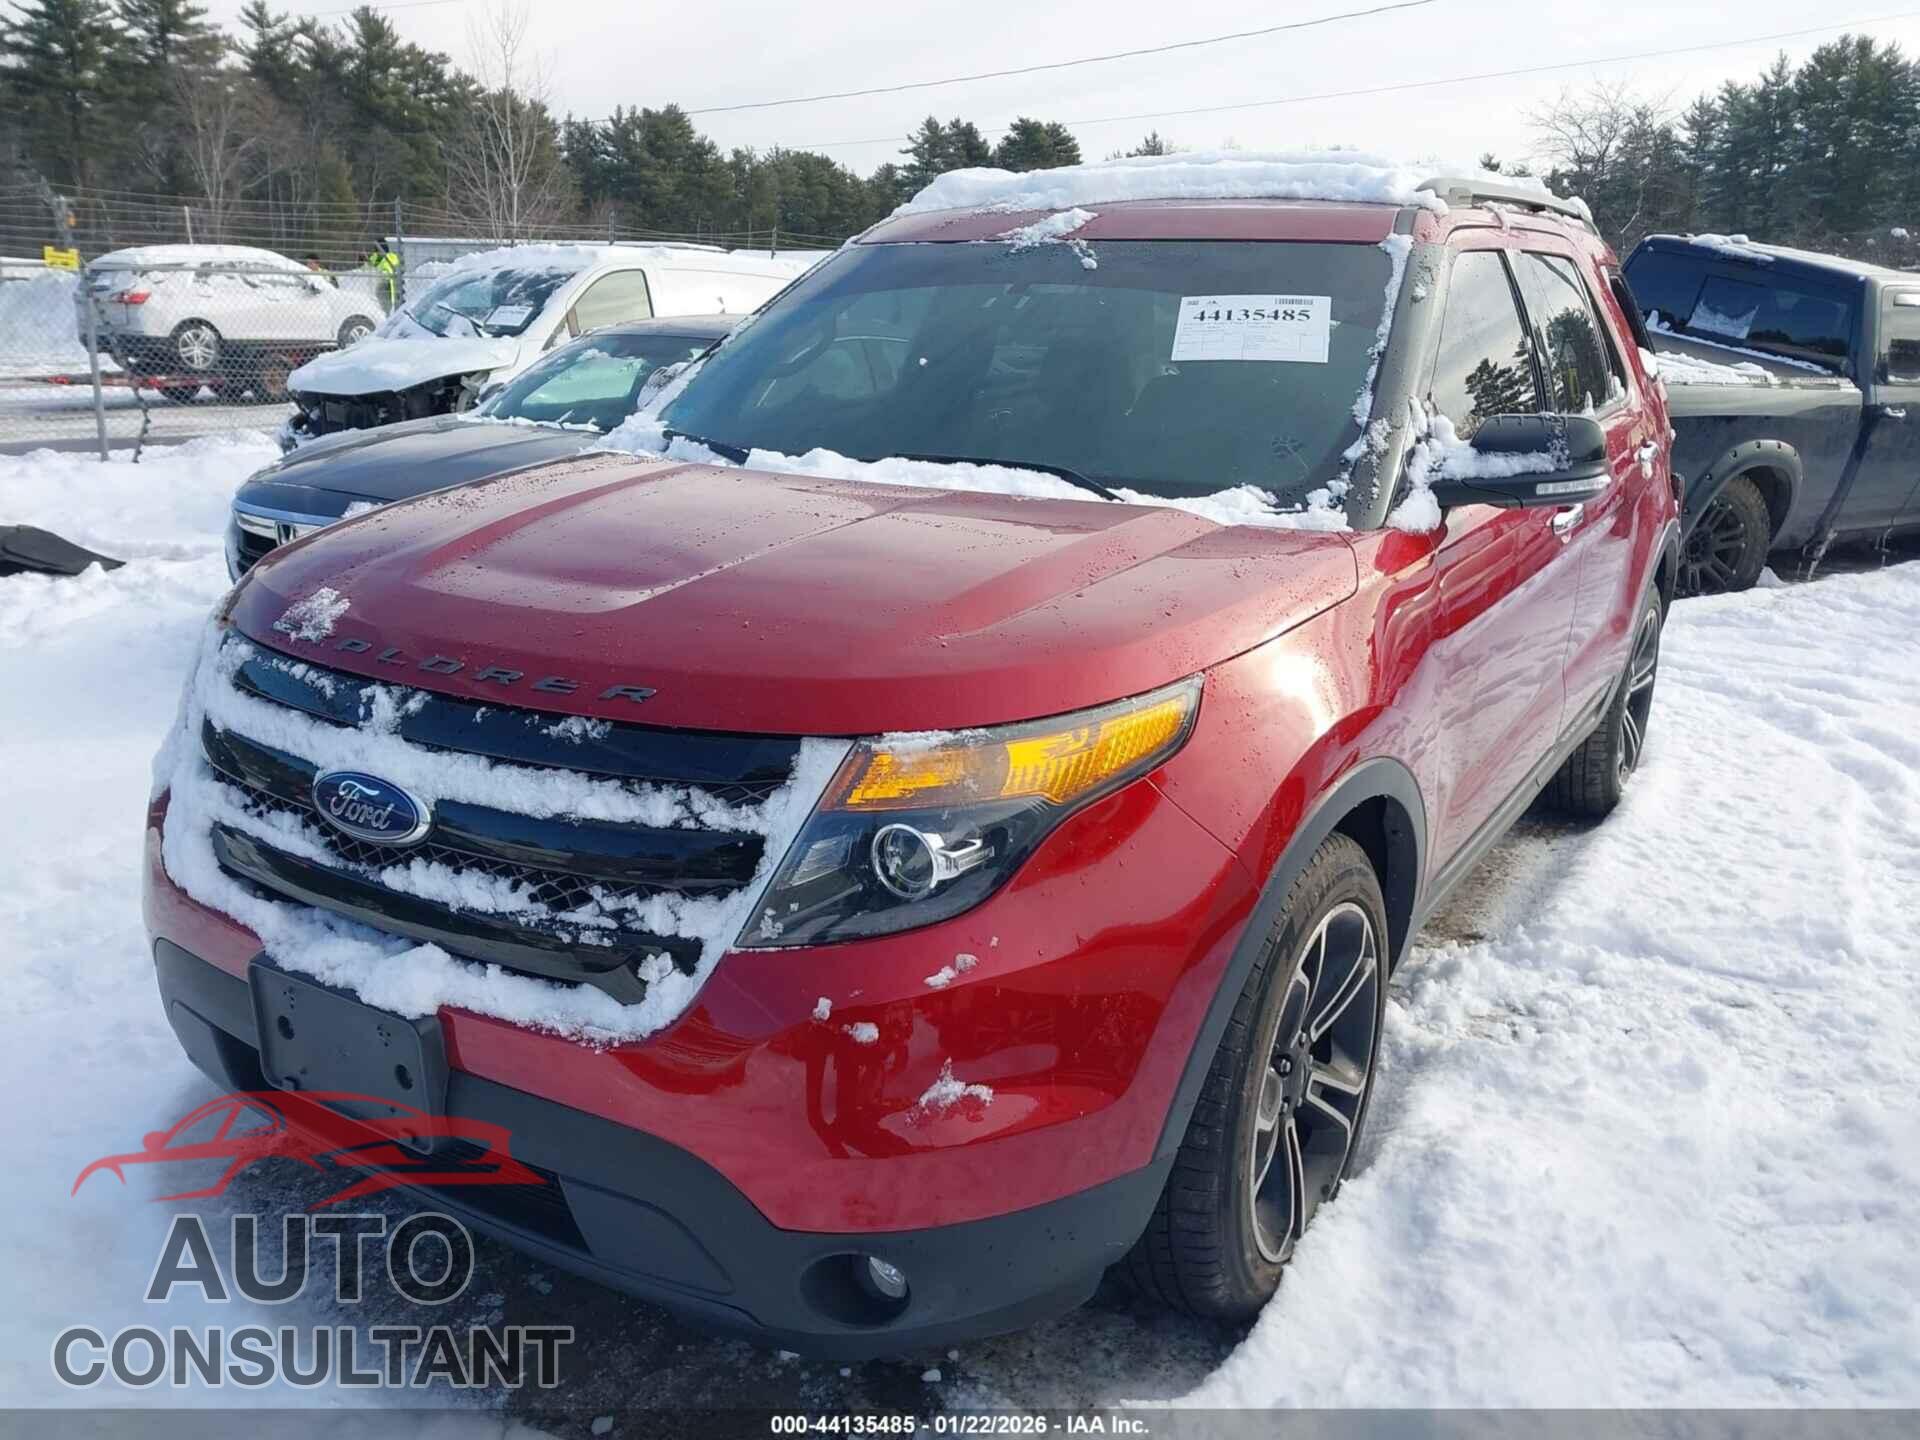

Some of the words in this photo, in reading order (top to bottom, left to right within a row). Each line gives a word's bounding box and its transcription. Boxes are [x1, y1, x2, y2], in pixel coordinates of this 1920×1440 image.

[1193, 309, 1311, 322] 44135485
[274, 620, 658, 703] PLORER
[329, 780, 395, 830] Ford
